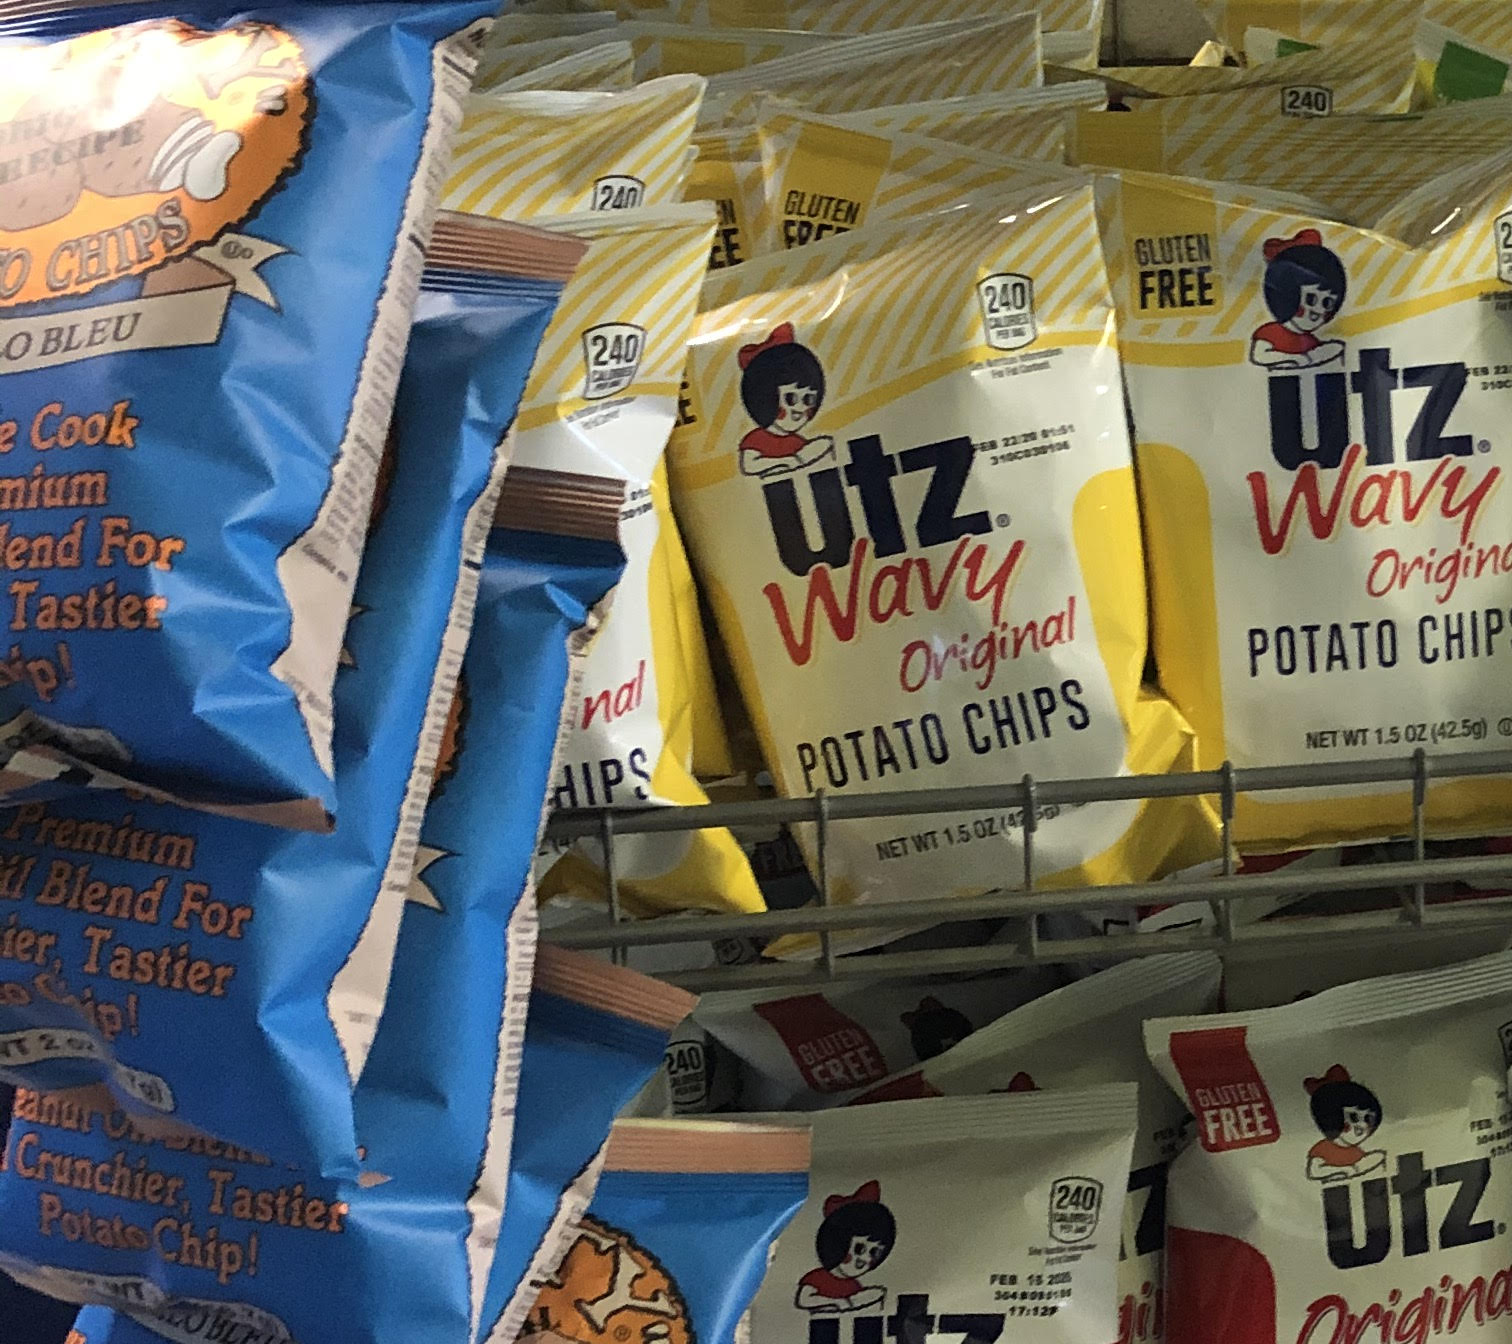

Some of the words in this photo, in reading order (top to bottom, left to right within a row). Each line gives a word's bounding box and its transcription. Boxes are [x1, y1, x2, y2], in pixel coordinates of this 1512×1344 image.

[1287, 91, 1328, 113] 240
[46, 196, 191, 292] CHIPS
[1133, 231, 1213, 267] GLUTEN
[985, 283, 1025, 314] 240
[1138, 266, 1216, 310] FREE
[41, 312, 143, 354] BLEU
[595, 335, 639, 368] 240
[30, 401, 139, 452] Cook
[1247, 444, 1501, 557] Wavy
[101, 518, 185, 570] For
[9, 579, 168, 631] Tastier
[763, 536, 1026, 667] Wavy
[900, 596, 1076, 693] Original
[1248, 619, 1399, 678] POTATO
[797, 711, 951, 794] POTATO
[961, 679, 1092, 756] CHIPS
[1305, 731, 1340, 749] NET
[1342, 728, 1370, 747] WT
[1375, 726, 1402, 745] 1.5
[1404, 722, 1429, 742] OZ
[1431, 718, 1488, 744] (42.5g)
[5, 800, 196, 868] Premium
[875, 837, 908, 860] NET
[911, 830, 939, 852] WT
[944, 825, 970, 846] 1.5
[973, 817, 998, 838] OZ
[38, 861, 172, 924] Blend
[173, 882, 253, 940] For
[1197, 1082, 1261, 1106] GLUTEN
[1204, 1106, 1273, 1144] FREE
[16, 1134, 191, 1213] Crunchier,
[206, 1172, 347, 1233] Tastier
[1055, 1187, 1096, 1211] 240
[39, 1193, 148, 1250] Potato
[153, 1217, 258, 1284] Chip!
